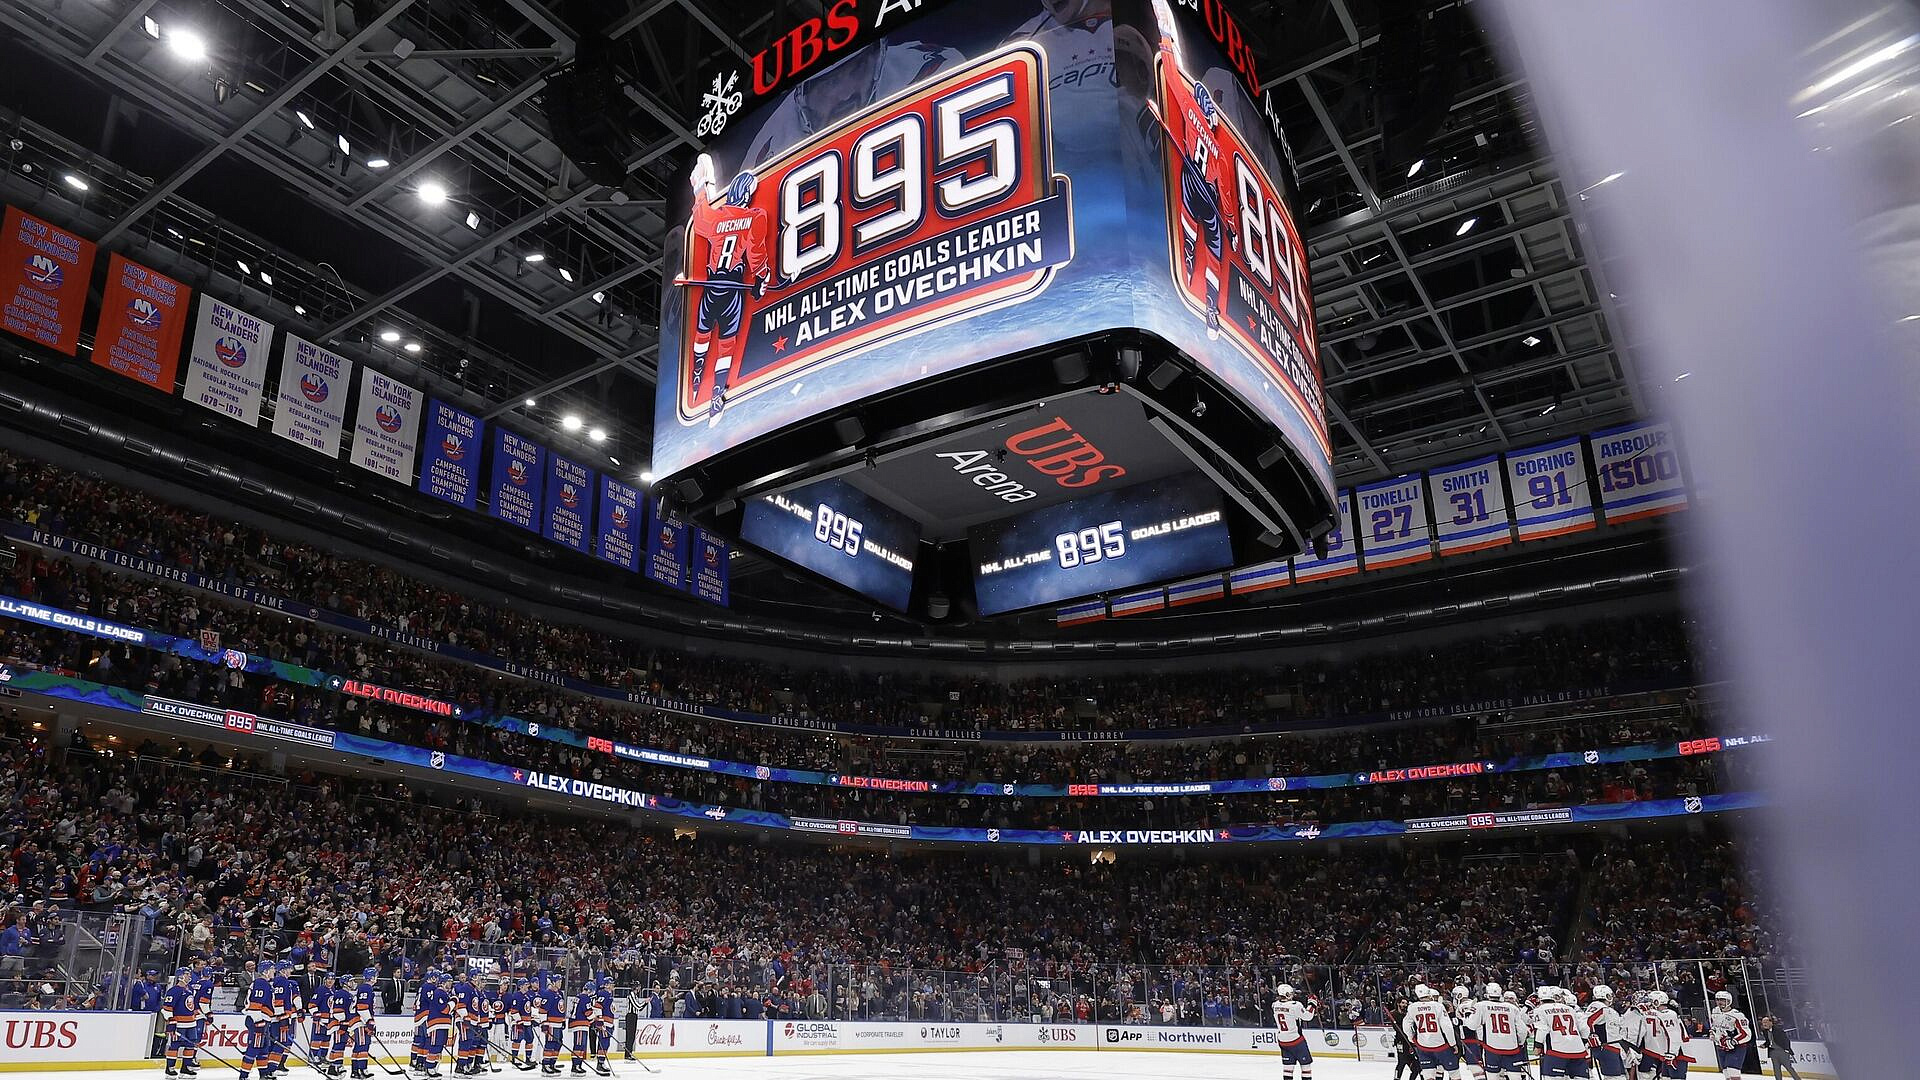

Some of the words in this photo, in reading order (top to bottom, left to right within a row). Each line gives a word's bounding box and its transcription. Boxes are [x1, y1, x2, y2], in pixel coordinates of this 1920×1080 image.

[751, 0, 859, 97] UBS
[1206, 0, 1260, 97] UBS
[1188, 108, 1219, 159] OVECHKIN
[1265, 89, 1300, 191] Arena
[778, 71, 1021, 282] 895
[21, 217, 47, 238] NEW
[51, 230, 80, 252] YORK
[716, 216, 753, 233] OVECHKIN
[18, 231, 79, 265] ISLANDERS
[718, 234, 738, 270] 8
[1234, 152, 1318, 365] 895
[764, 303, 797, 334] NHL
[800, 266, 880, 317] ALL-TIME
[884, 240, 950, 284] GOALS
[955, 210, 1041, 260] LEADER
[795, 296, 868, 347] ALEX
[875, 238, 1042, 314] OVECHKIN
[1238, 276, 1259, 313] NHL
[211, 314, 259, 344] ISLANDERS
[213, 303, 234, 321] NEW
[238, 314, 261, 333] YORK
[297, 342, 317, 358] NEW
[320, 351, 341, 369] YORK
[1260, 323, 1291, 375] ALEX
[193, 356, 219, 372] NATIONAL
[220, 366, 240, 381] HOCKEY
[242, 377, 261, 390] LEAGUE
[296, 353, 339, 380] ISLANDERS
[203, 372, 227, 388] REGULAR
[228, 382, 248, 396] SEASON
[208, 386, 239, 403] CHAMPIONS
[373, 375, 391, 391] NEW
[393, 384, 413, 400] YORK
[372, 386, 411, 410] ISLANDERS
[438, 416, 474, 439] ISLANDERS
[439, 405, 455, 419] NEW
[457, 412, 475, 429] YORK
[503, 443, 536, 465] ISLANDERS
[504, 434, 518, 446] NEW
[520, 441, 537, 455] YORK
[1005, 416, 1127, 488] UBS
[1600, 431, 1667, 459] ARBOUR
[431, 465, 469, 487] CONFERENCE
[435, 458, 467, 476] CAMPBELL
[556, 458, 569, 470] NEW
[571, 464, 586, 478] YORK
[936, 448, 1037, 504] Arena
[1515, 451, 1576, 477] GORING
[1600, 451, 1680, 494] 1500
[431, 475, 467, 495] CHAMPIONS
[556, 467, 586, 488] ISLANDERS
[1442, 470, 1490, 492] SMITH
[498, 490, 533, 509] CONFERENCE
[502, 483, 531, 501] CAMPBELL
[607, 489, 636, 509] ISLANDERS
[608, 480, 621, 492] NEW
[622, 485, 637, 500] YORK
[1362, 485, 1418, 509] TONELLI
[1528, 471, 1573, 510] 91
[499, 500, 531, 518] CHAMPIONS
[1449, 489, 1490, 526] 31
[774, 495, 813, 522] ALL-TIME
[814, 503, 864, 558] 895
[864, 539, 887, 559] GOALS
[887, 551, 913, 572] LEADER
[1372, 505, 1412, 542] 27
[980, 562, 1002, 575] NHL
[1003, 550, 1051, 570] ALL-TIME
[1055, 520, 1126, 570] 895
[1131, 523, 1171, 540] GOALS
[1173, 511, 1220, 530] LEADER
[32, 530, 63, 549] NEW
[71, 541, 108, 562] YORK
[114, 551, 189, 584] ISLANDERS
[199, 576, 229, 596] HALL
[235, 585, 250, 600] OF
[254, 592, 285, 610] FAME
[0, 599, 51, 621] LL-TIME
[53, 612, 95, 632] GOALS
[97, 622, 144, 643] LEADER
[370, 625, 389, 638] PAT
[394, 630, 441, 653] FLATLEY
[505, 662, 517, 673] ED
[521, 665, 566, 687] WESTFALL
[343, 680, 381, 699] ALEX
[383, 689, 452, 716] OVECHKIN
[628, 692, 657, 707] BRYAN
[662, 698, 704, 714] TROTTIER
[152, 702, 177, 714] ALEX
[179, 707, 224, 724] OVECHKIN
[228, 713, 253, 731] 895
[256, 722, 269, 731] NHL
[268, 724, 294, 736] ALL-TIME
[293, 728, 312, 739] GOALS
[312, 731, 333, 744] LEADER
[772, 715, 799, 727] DENIS
[803, 718, 837, 731] POTVIN
[910, 728, 940, 738] CLARK
[945, 730, 981, 739] GILLIES
[1061, 732, 1083, 740] BILL
[1087, 731, 1126, 740] TORREY
[1679, 737, 1721, 755] 895
[1725, 736, 1748, 747] NHL
[587, 736, 612, 754] 895
[615, 745, 627, 754] NHL
[628, 748, 658, 761] ALL-TIME
[659, 753, 682, 764] GOALS
[683, 757, 709, 768] LEADER
[839, 776, 868, 788] ALEX
[871, 779, 928, 791] OVECHKIN
[1369, 768, 1405, 783] ALEX
[1408, 762, 1483, 780] OVECHKIN
[527, 771, 569, 793] ALEX
[572, 780, 646, 808] OVECHKIN
[1068, 784, 1098, 797] 895
[1102, 786, 1117, 794] NHL
[1119, 786, 1152, 794] ALL-TIME
[1154, 785, 1179, 793] GOALS
[1180, 784, 1210, 792] LEADER
[840, 822, 856, 833] 895
[1412, 820, 1430, 829] ALEX
[1431, 819, 1467, 828] OVECHKIN
[1471, 815, 1493, 827] 895
[1078, 830, 1123, 843] ALEX
[1126, 829, 1214, 844] OVECHKIN
[254, 989, 263, 998] 10
[6, 1021, 78, 1049] UBS
[385, 1031, 400, 1039] app
[797, 1023, 837, 1032] GLOBAL
[930, 1027, 960, 1038] TAYLOR
[1052, 1029, 1076, 1041] UBS
[1277, 1014, 1288, 1032] 6
[1415, 1013, 1438, 1034] 26
[1490, 1013, 1511, 1035] 16
[1552, 1014, 1578, 1036] 42
[1158, 1032, 1221, 1043] Northwell
[1252, 1032, 1277, 1045] jetBl
